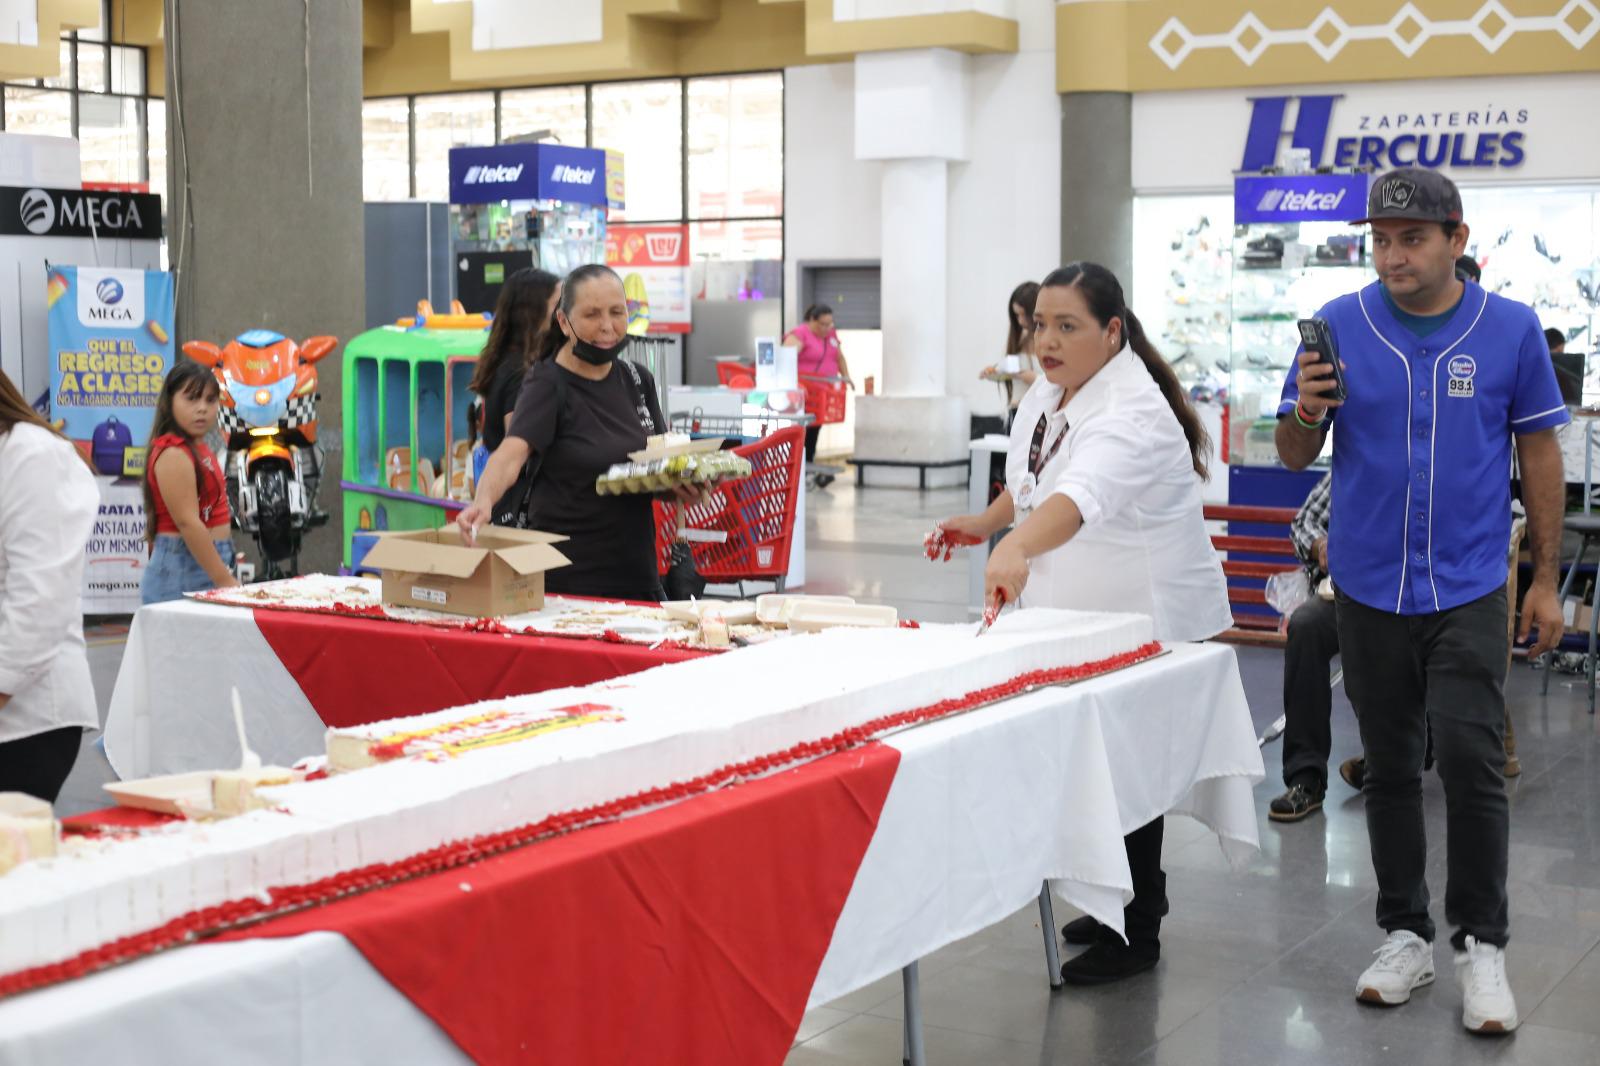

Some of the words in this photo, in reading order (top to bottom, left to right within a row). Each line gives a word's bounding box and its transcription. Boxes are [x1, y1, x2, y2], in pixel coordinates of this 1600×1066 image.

[1359, 104, 1528, 130] ZAPATERÍAS
[1232, 94, 1525, 174] HERCULES
[478, 163, 524, 184] telcel
[562, 165, 596, 185] telcel
[1282, 188, 1346, 211] telcel
[59, 196, 143, 229] MEGA
[88, 307, 133, 321] MEGA
[88, 340, 117, 353] QUE
[119, 340, 137, 354] EL
[59, 352, 164, 373] REGRESO
[60, 373, 80, 393] A
[81, 373, 164, 393] CLASES
[1450, 380, 1473, 391] 93.1
[85, 539, 106, 553] HOY
[109, 539, 144, 553] MISMO
